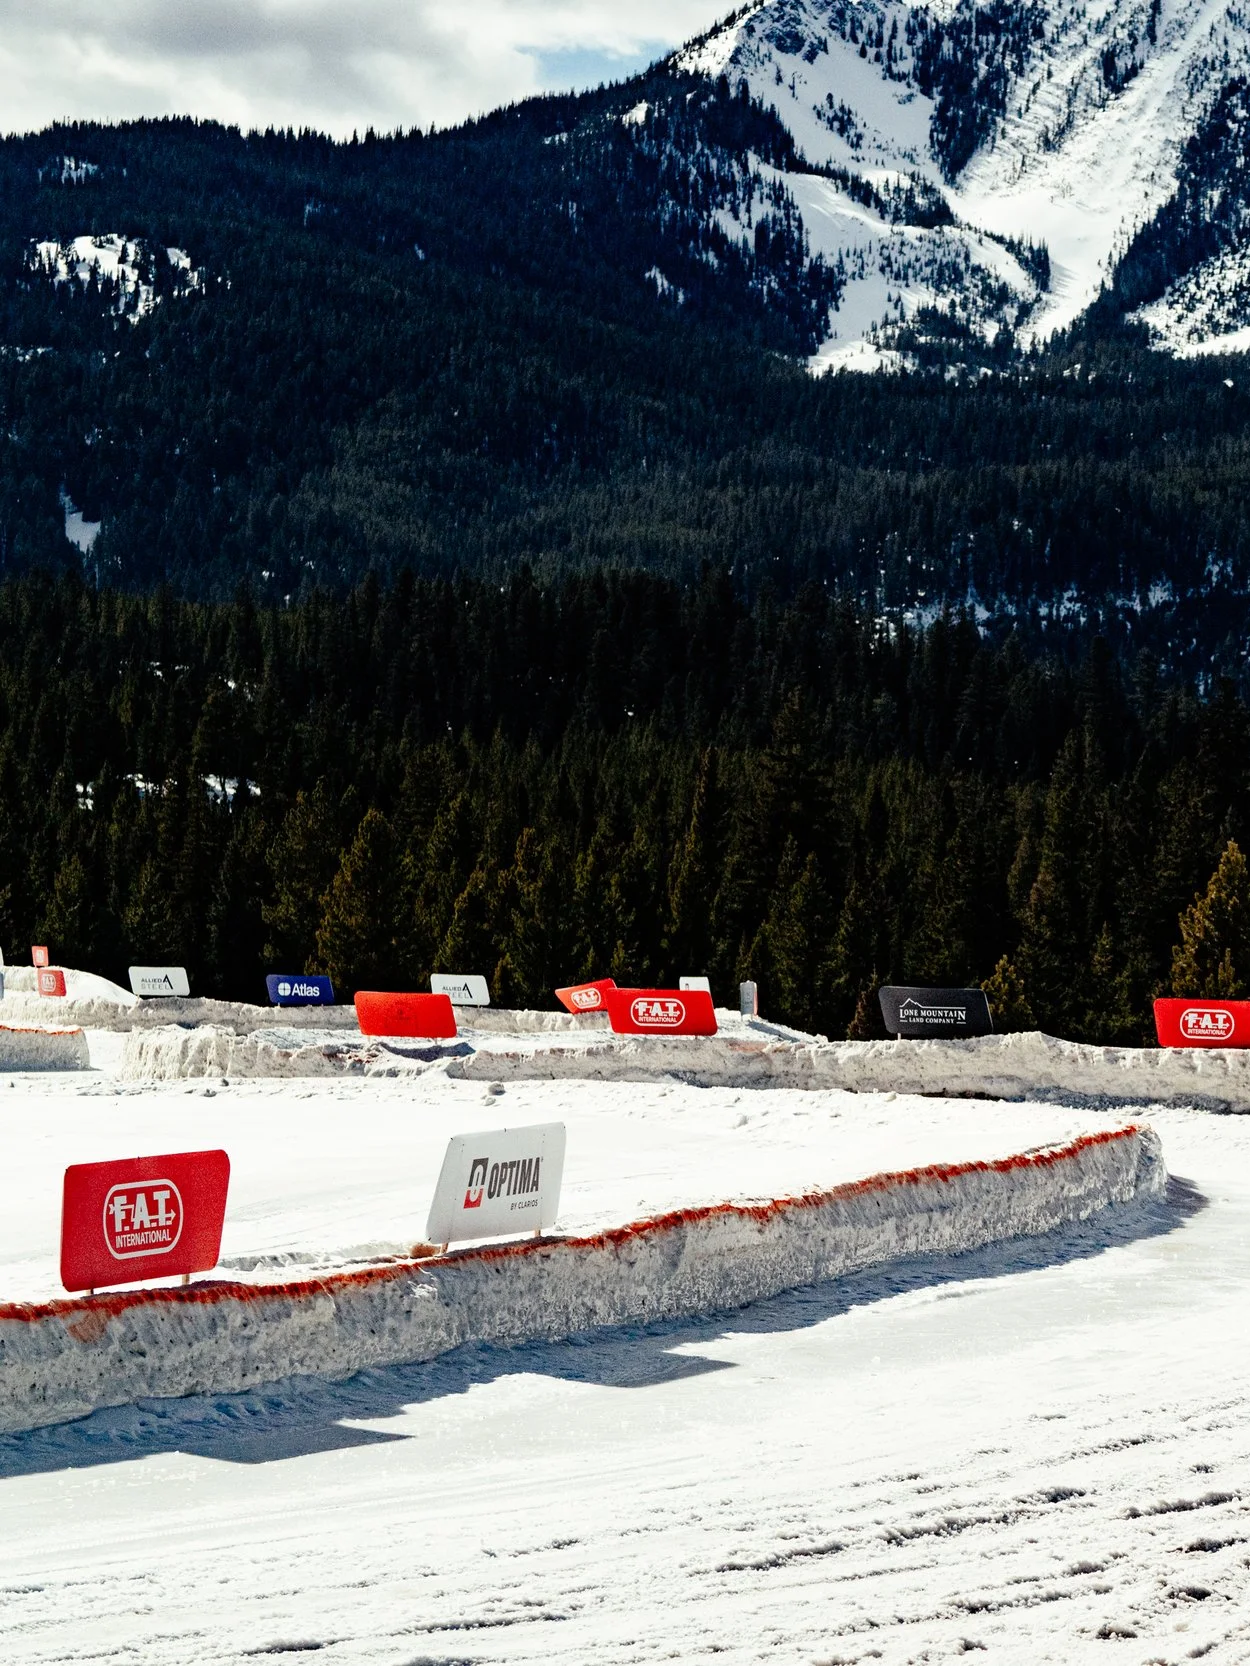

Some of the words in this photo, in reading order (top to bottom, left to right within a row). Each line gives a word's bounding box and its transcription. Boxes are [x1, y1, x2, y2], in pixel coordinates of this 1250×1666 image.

[292, 983, 320, 997] Atlas
[635, 1001, 680, 1017] F.A.T.
[900, 1008, 919, 1019] LONE
[920, 1009, 966, 1020] MOUNTAIN
[1185, 1013, 1229, 1029] F.A.T.
[487, 1157, 540, 1200] OPTIMA
[110, 1190, 175, 1233] F.A.T.
[510, 1202, 518, 1211] BY
[518, 1199, 538, 1210] CLARIOS
[115, 1229, 172, 1249] INTERNATIONAL
